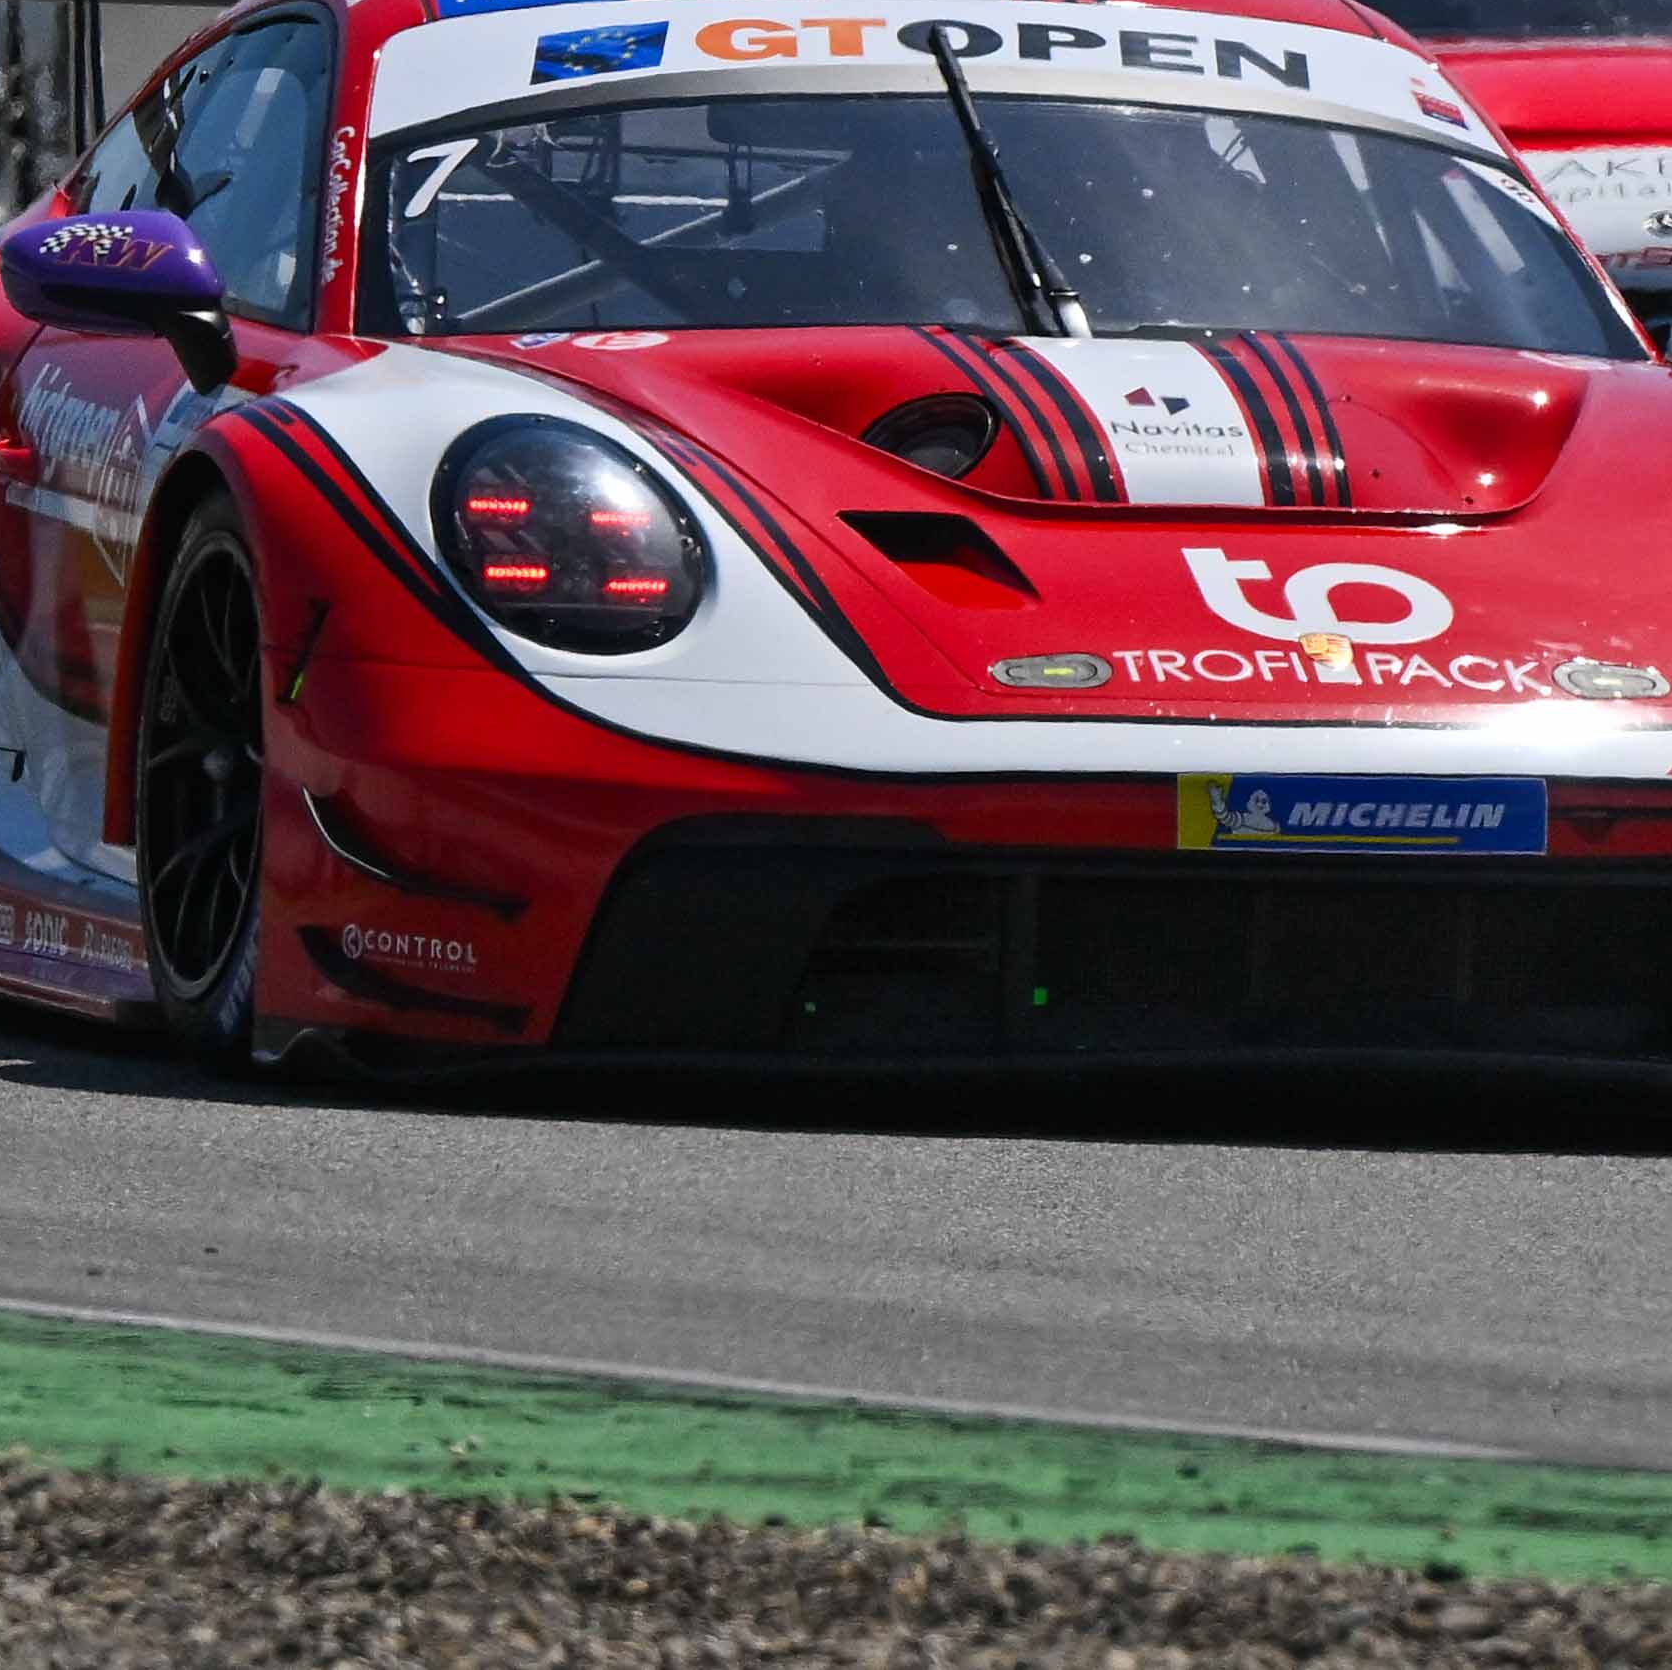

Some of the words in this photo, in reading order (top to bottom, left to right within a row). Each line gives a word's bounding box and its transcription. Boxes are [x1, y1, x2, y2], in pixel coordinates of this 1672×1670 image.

[403, 138, 479, 219] 7
[1110, 419, 1244, 440] Navitas
[1124, 440, 1236, 460] Chemical
[1113, 649, 1308, 685] TROFI
[1368, 652, 1553, 696] PACK
[1287, 801, 1507, 831] MICHELIN
[363, 929, 478, 966] CONTROL
